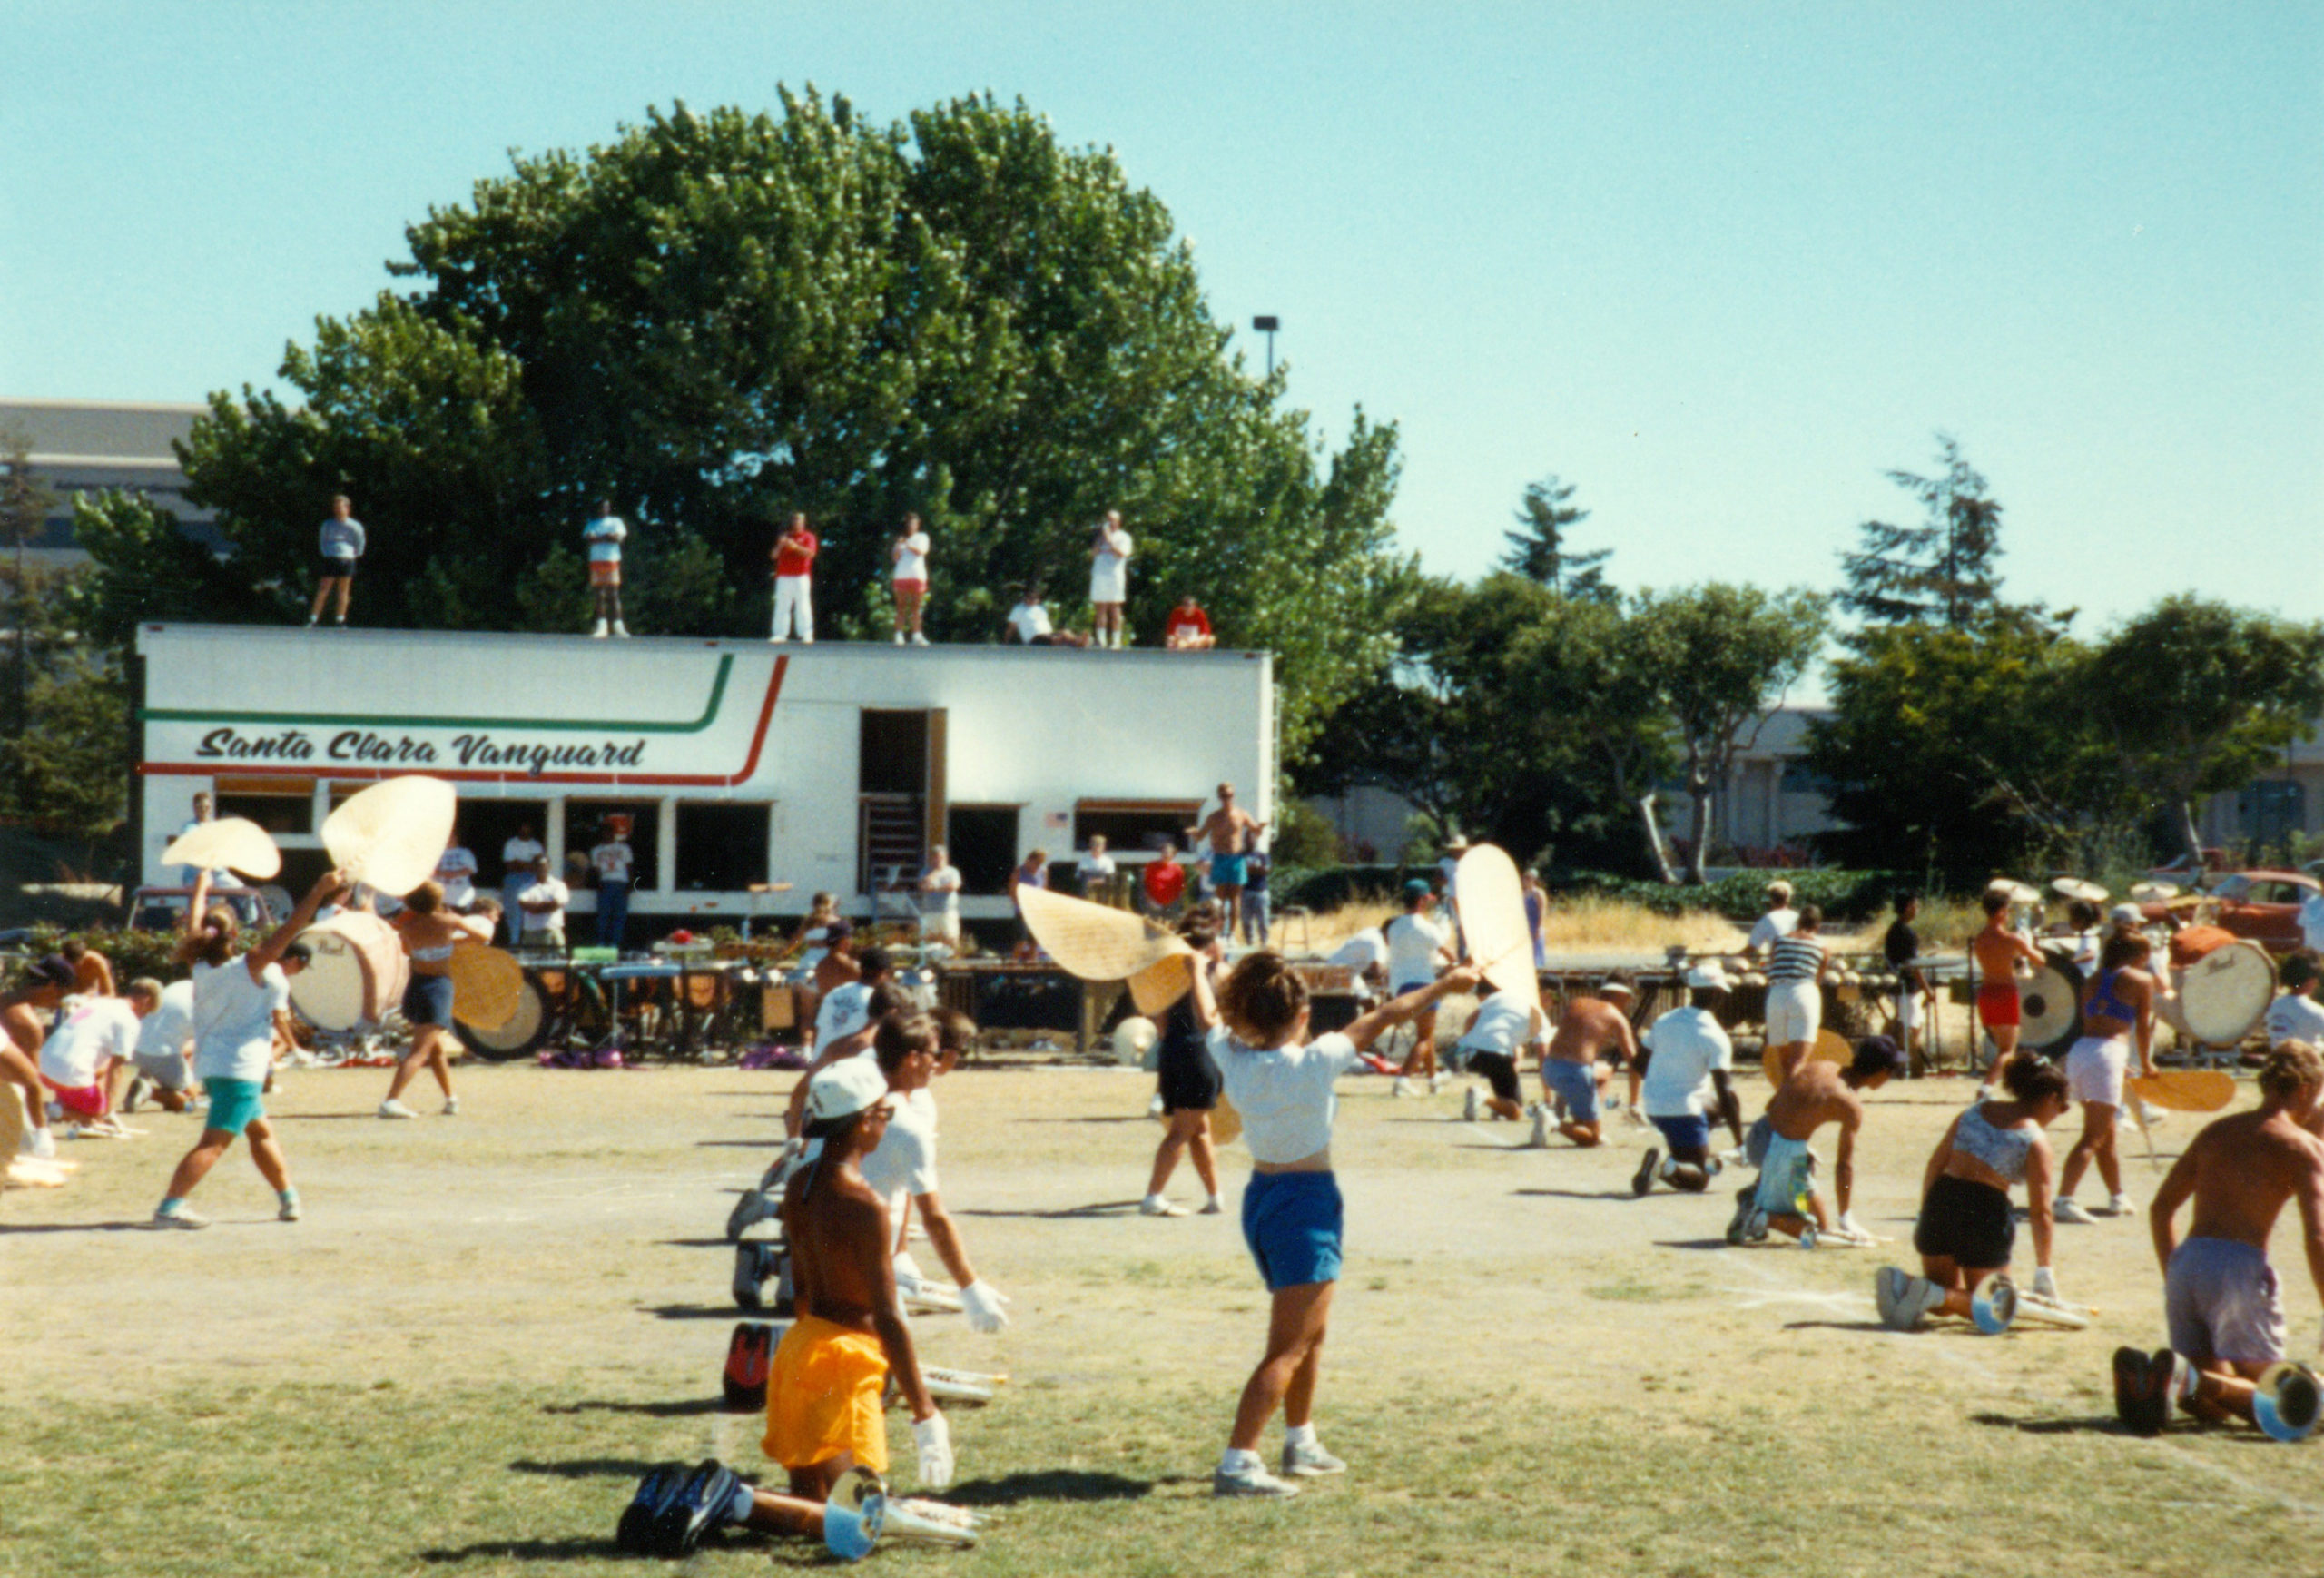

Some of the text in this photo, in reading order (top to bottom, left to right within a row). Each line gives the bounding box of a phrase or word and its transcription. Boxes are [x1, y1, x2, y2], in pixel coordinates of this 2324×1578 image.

[195, 727, 645, 777] Santa Clara Vanguard
